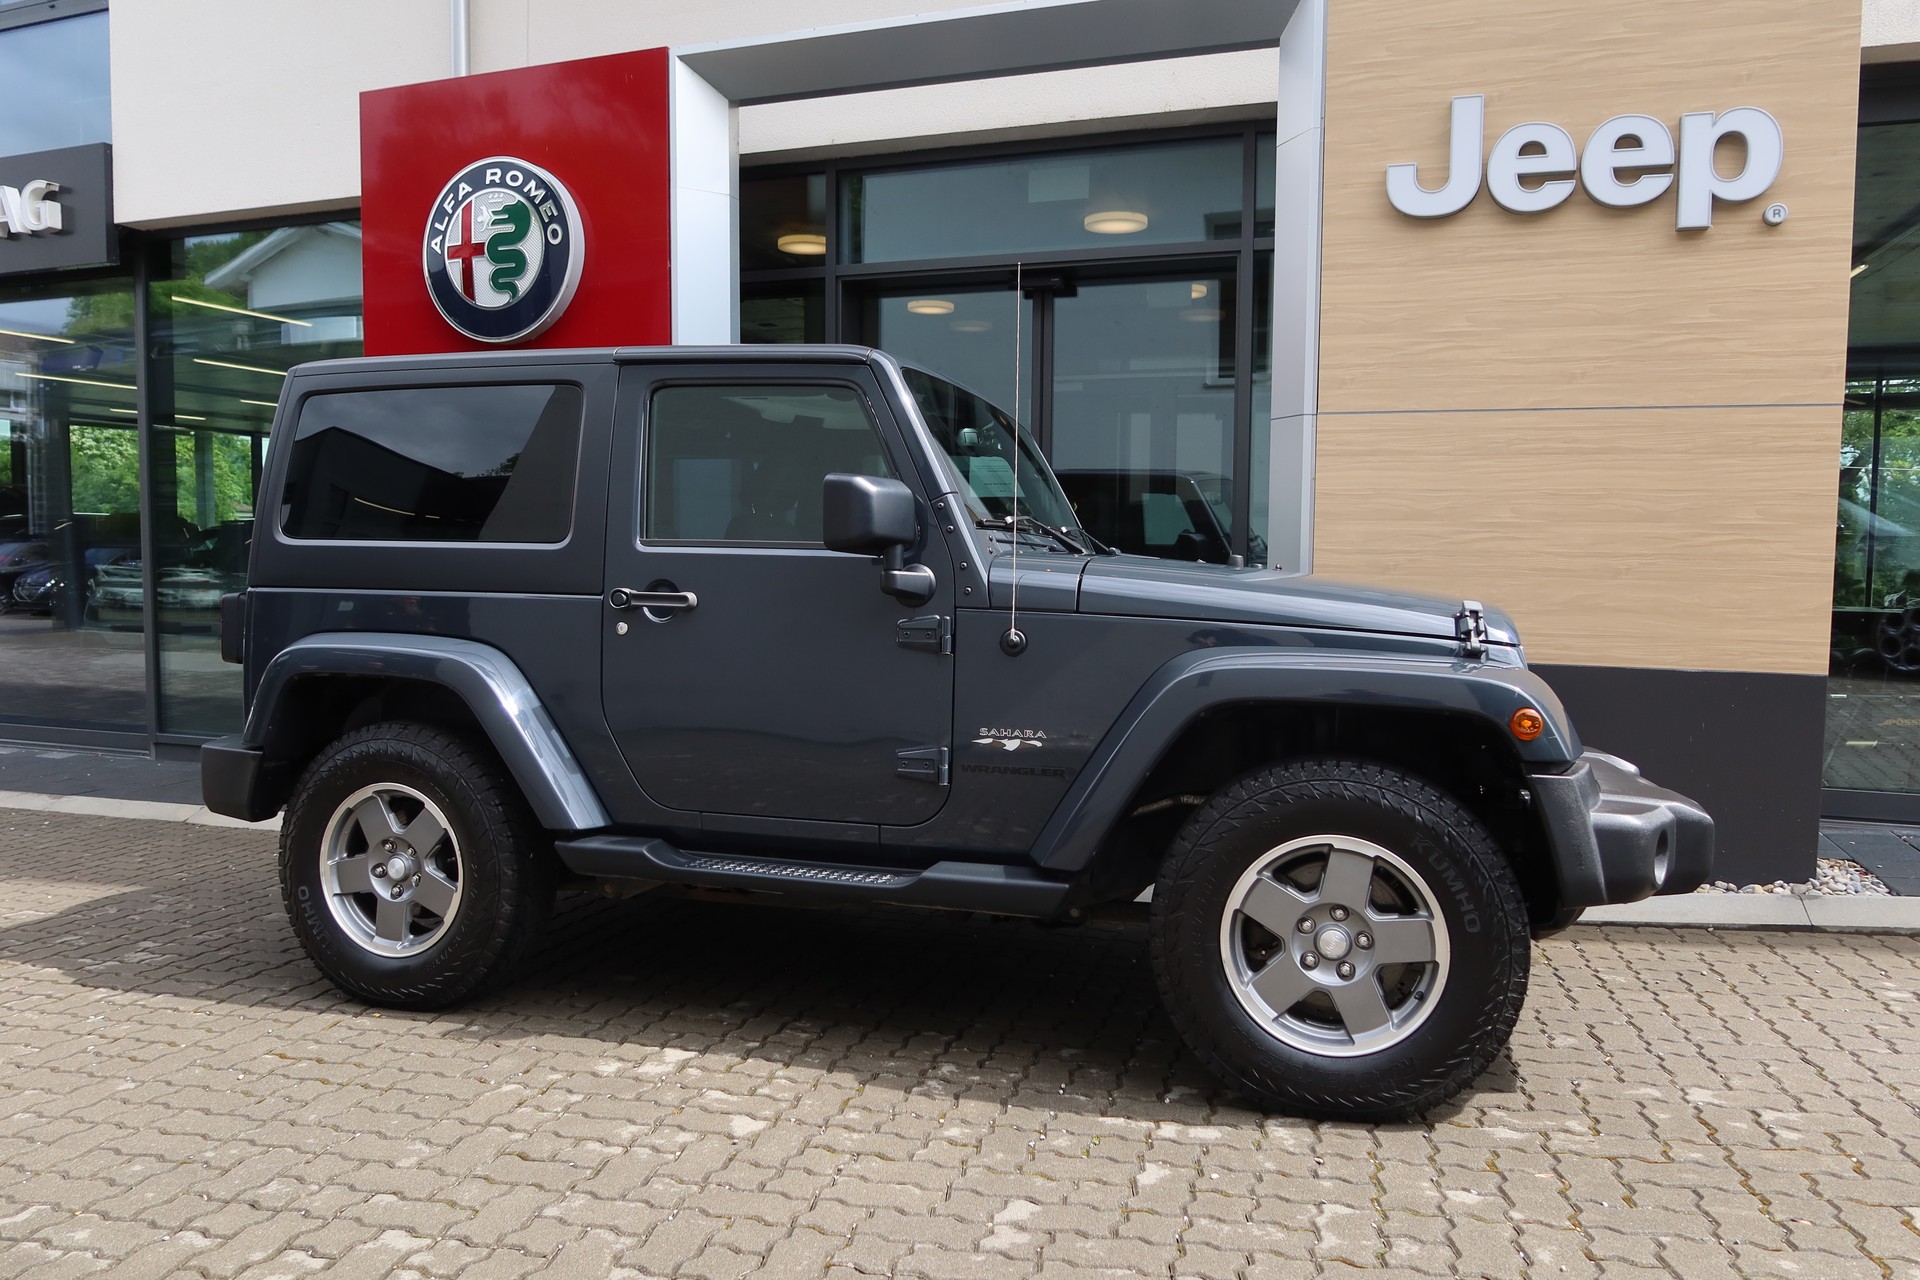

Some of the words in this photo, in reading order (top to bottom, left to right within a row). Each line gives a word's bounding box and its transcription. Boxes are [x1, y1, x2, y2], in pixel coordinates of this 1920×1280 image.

[1386, 93, 1784, 232] Jeep
[430, 181, 473, 255] ALFA
[485, 168, 563, 246] ROMEO
[961, 763, 1067, 778] WRANGLER
[979, 727, 1047, 739] SAHARA
[1409, 831, 1482, 935] KUMHO
